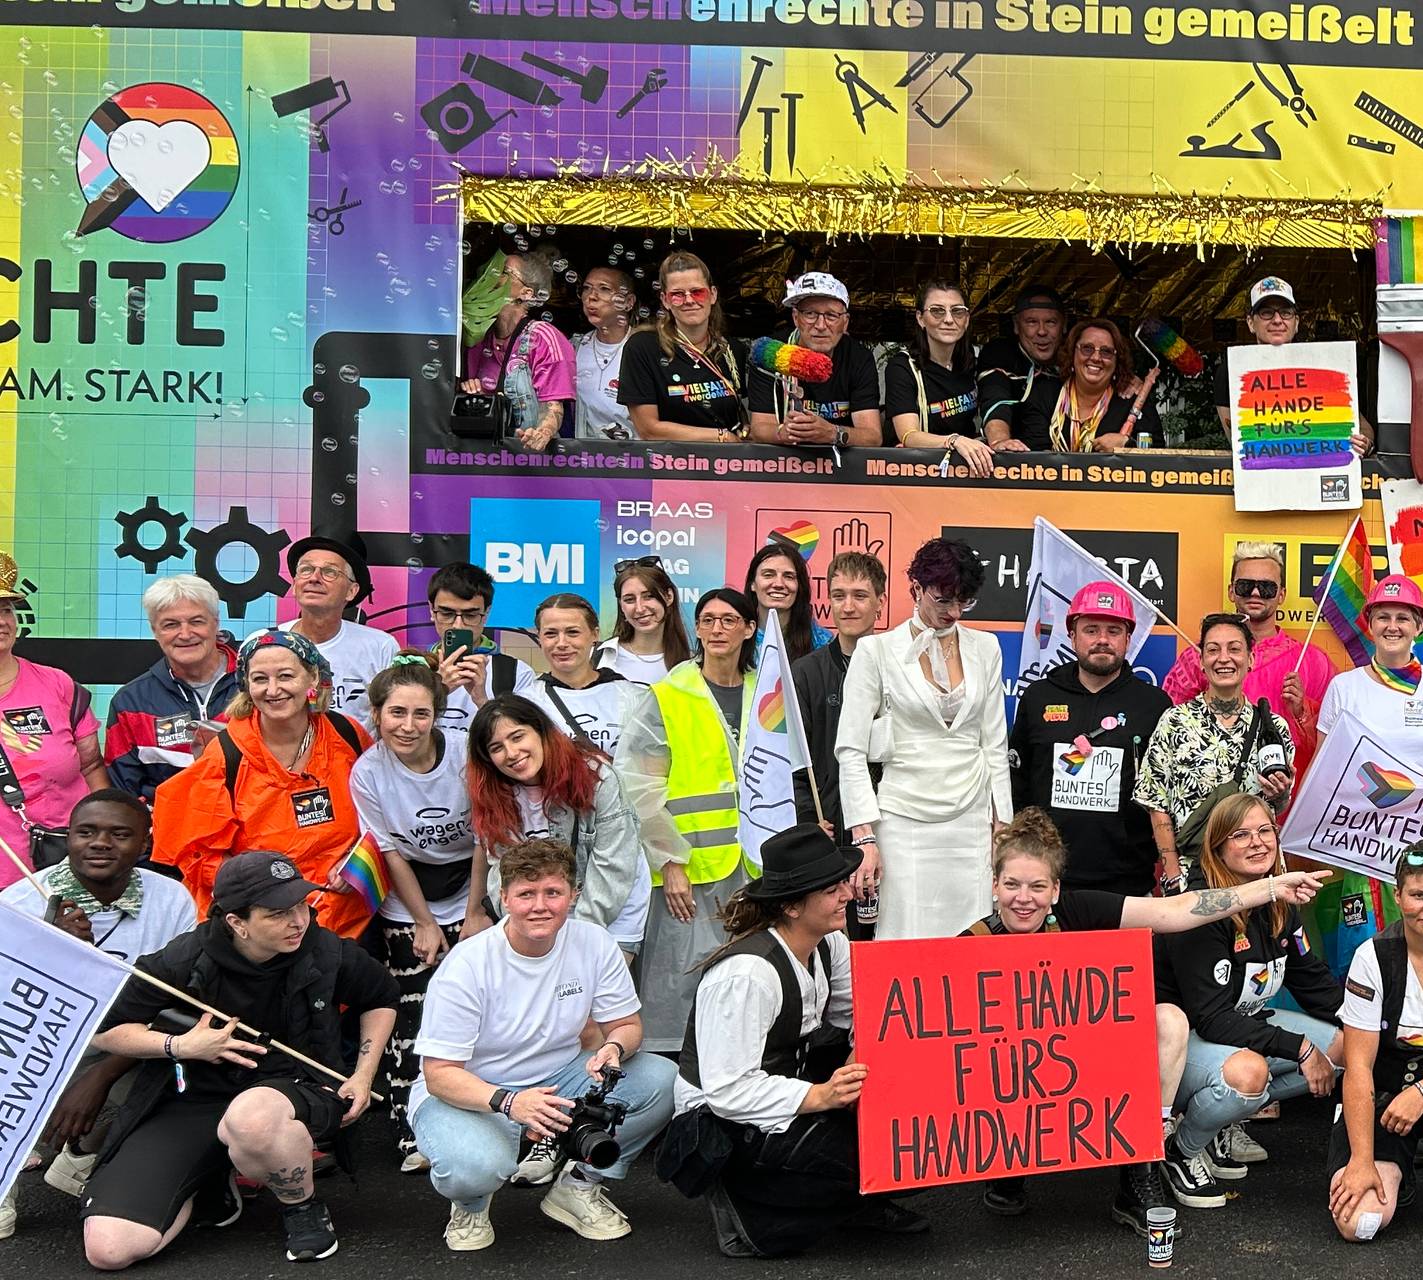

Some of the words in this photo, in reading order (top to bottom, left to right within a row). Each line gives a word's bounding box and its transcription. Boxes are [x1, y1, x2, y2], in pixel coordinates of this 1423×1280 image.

[935, 0, 983, 30] in
[995, 0, 1136, 35] Stein
[1143, 3, 1415, 46] gemeißelt
[85, 369, 223, 405] STARK!
[1250, 372, 1308, 394] ALLE
[1243, 438, 1344, 460] HANDWERK
[426, 448, 621, 468] Menschenrechte
[625, 452, 644, 468] in
[650, 453, 709, 472] Stein
[714, 453, 834, 475] gemeißelt
[1062, 464, 1083, 482] in
[1087, 465, 1146, 483] Stein
[616, 500, 713, 519] BRAAS
[616, 525, 696, 551] icopal
[485, 543, 585, 585] BMI
[1054, 780, 1104, 797] BUNTES
[1054, 796, 1111, 808] HANDWERK
[410, 819, 465, 838] wagen
[418, 829, 465, 849] engel
[877, 970, 1005, 1042] ALLE
[1013, 960, 1135, 1032] HÄNDE
[953, 1032, 1079, 1106] FÜRS
[891, 1093, 1136, 1182] HANDWERK
